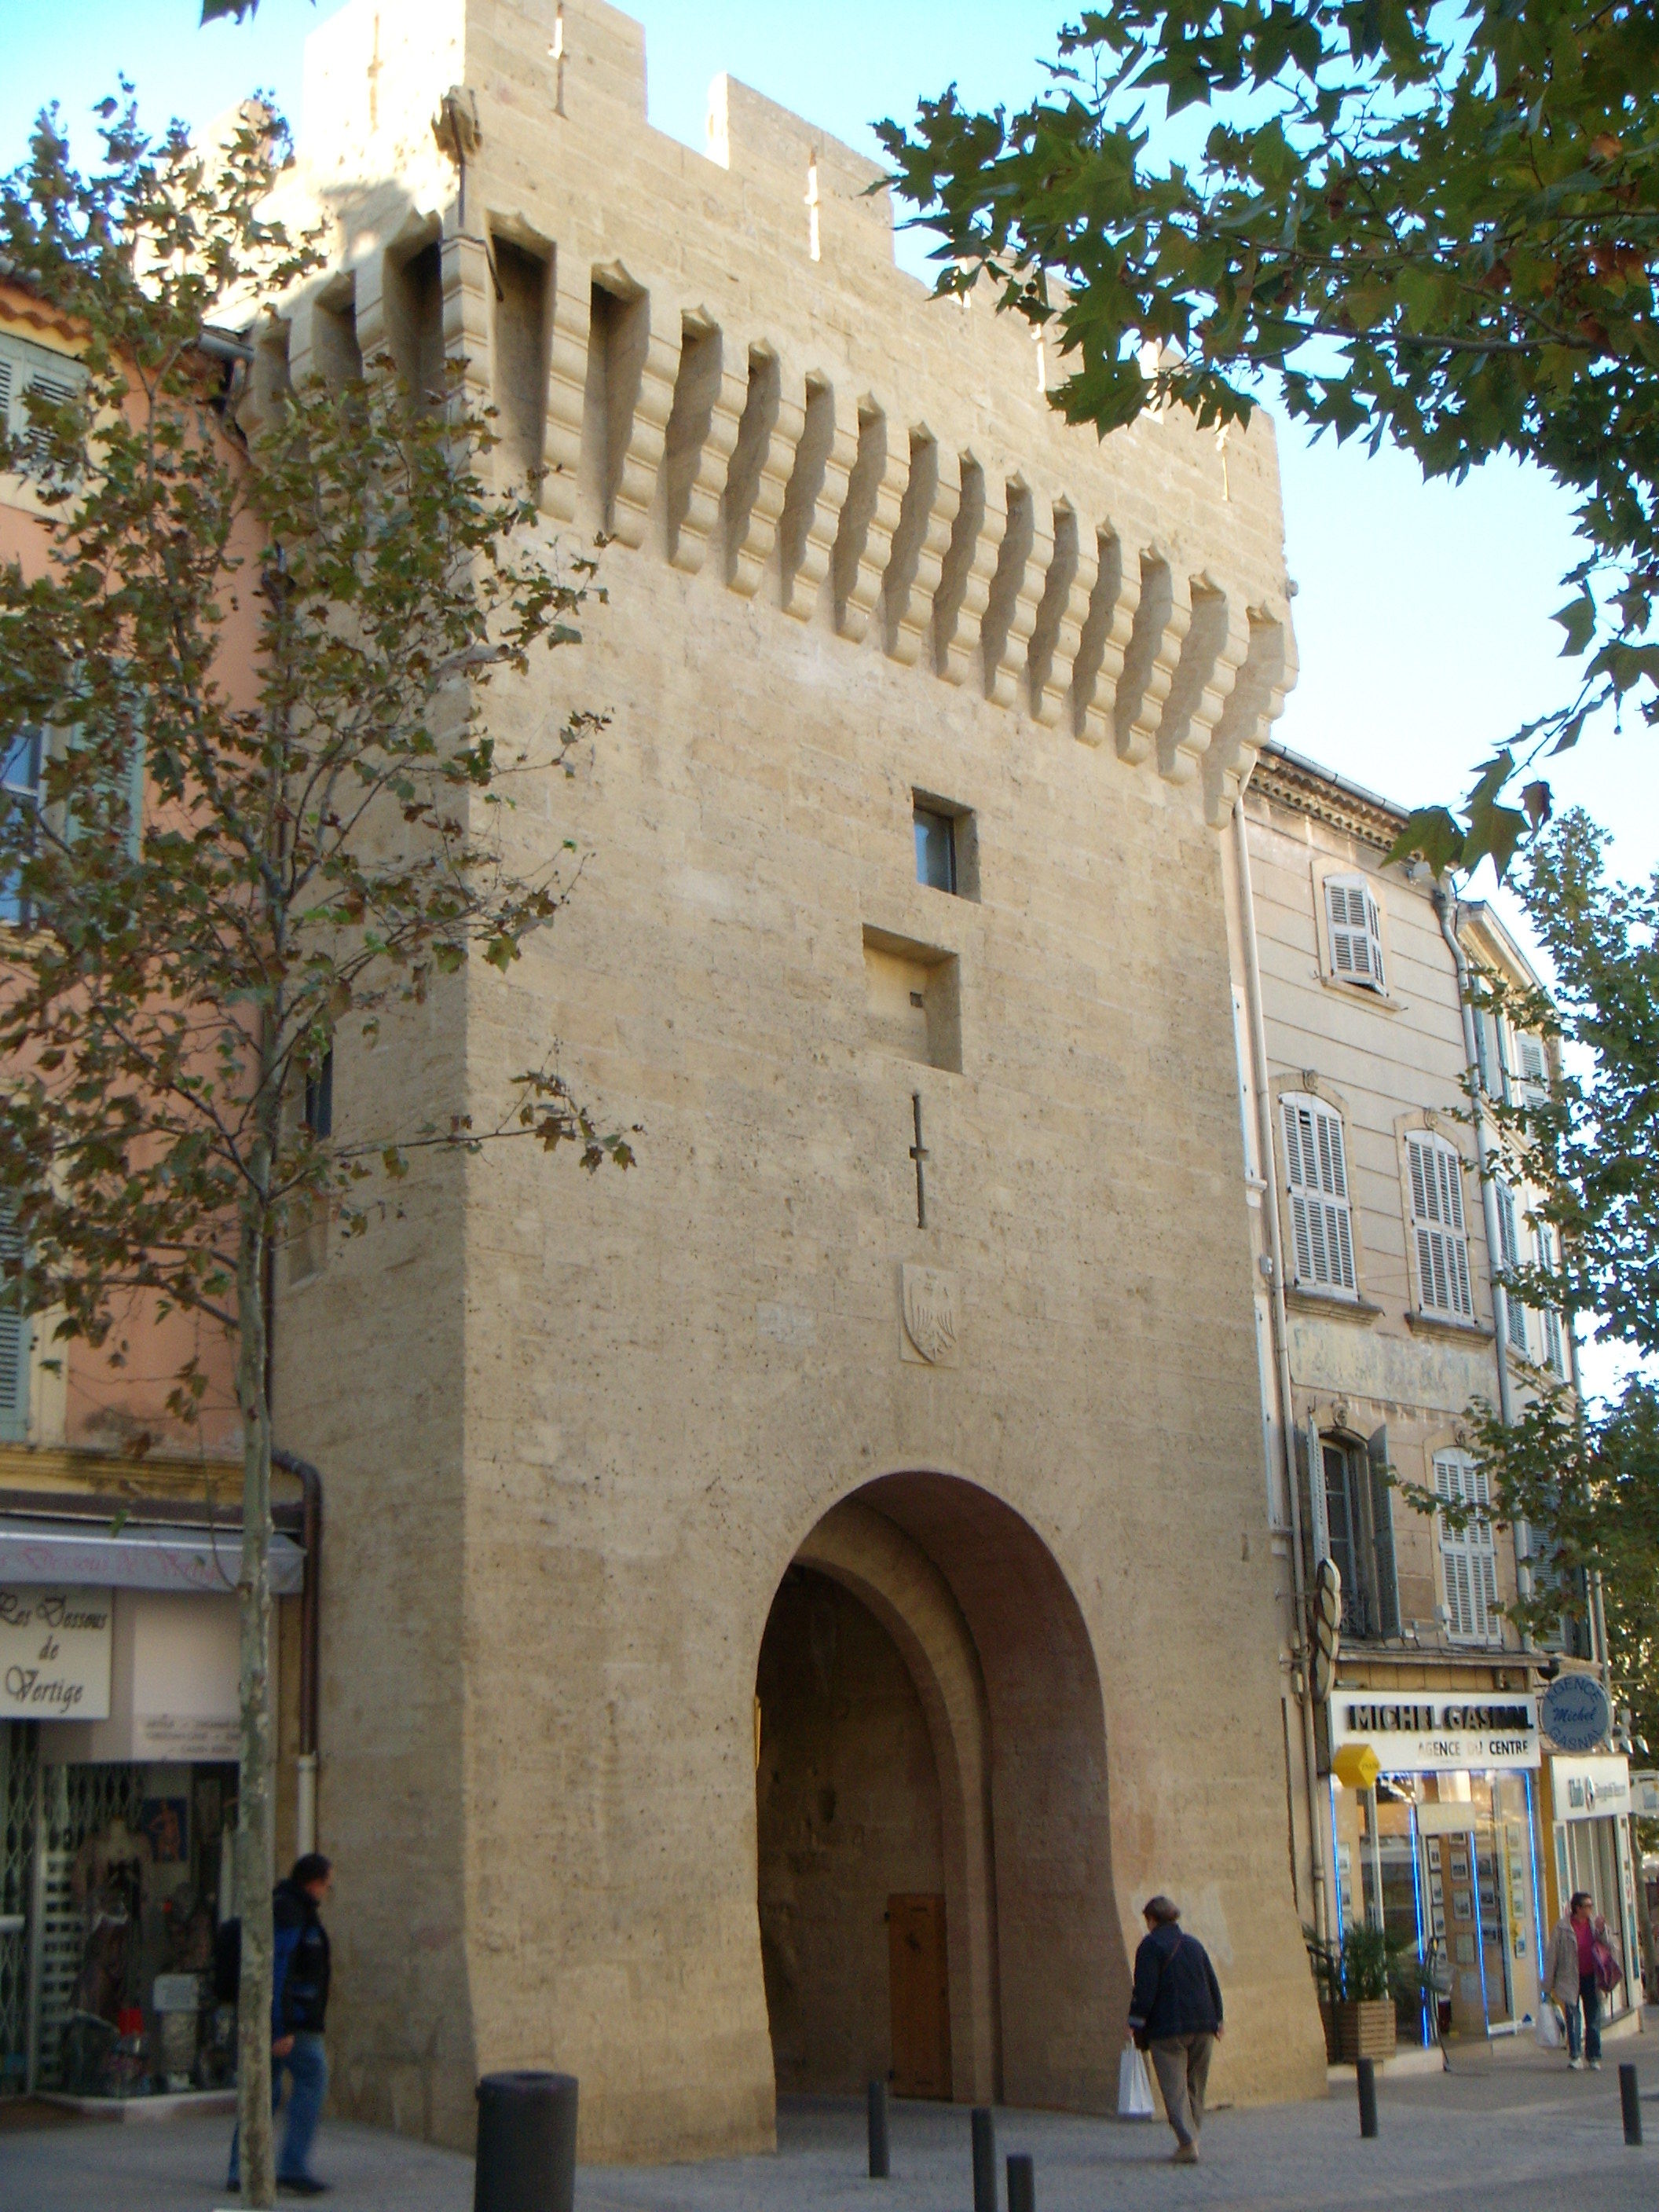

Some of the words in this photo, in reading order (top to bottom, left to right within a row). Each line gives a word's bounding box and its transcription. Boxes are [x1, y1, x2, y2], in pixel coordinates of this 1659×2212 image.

[37, 1594, 107, 1629] Dessous
[38, 1632, 60, 1661] de
[5, 1664, 83, 1714] Vertige
[1546, 1676, 1601, 1705] AGENCE
[1346, 1704, 1441, 1731] MICHEL
[1553, 1705, 1597, 1723] Michel
[1419, 1741, 1461, 1756] AGENCE
[1489, 1741, 1529, 1756] CENTRE
[1549, 1727, 1602, 1750] GASNAL
